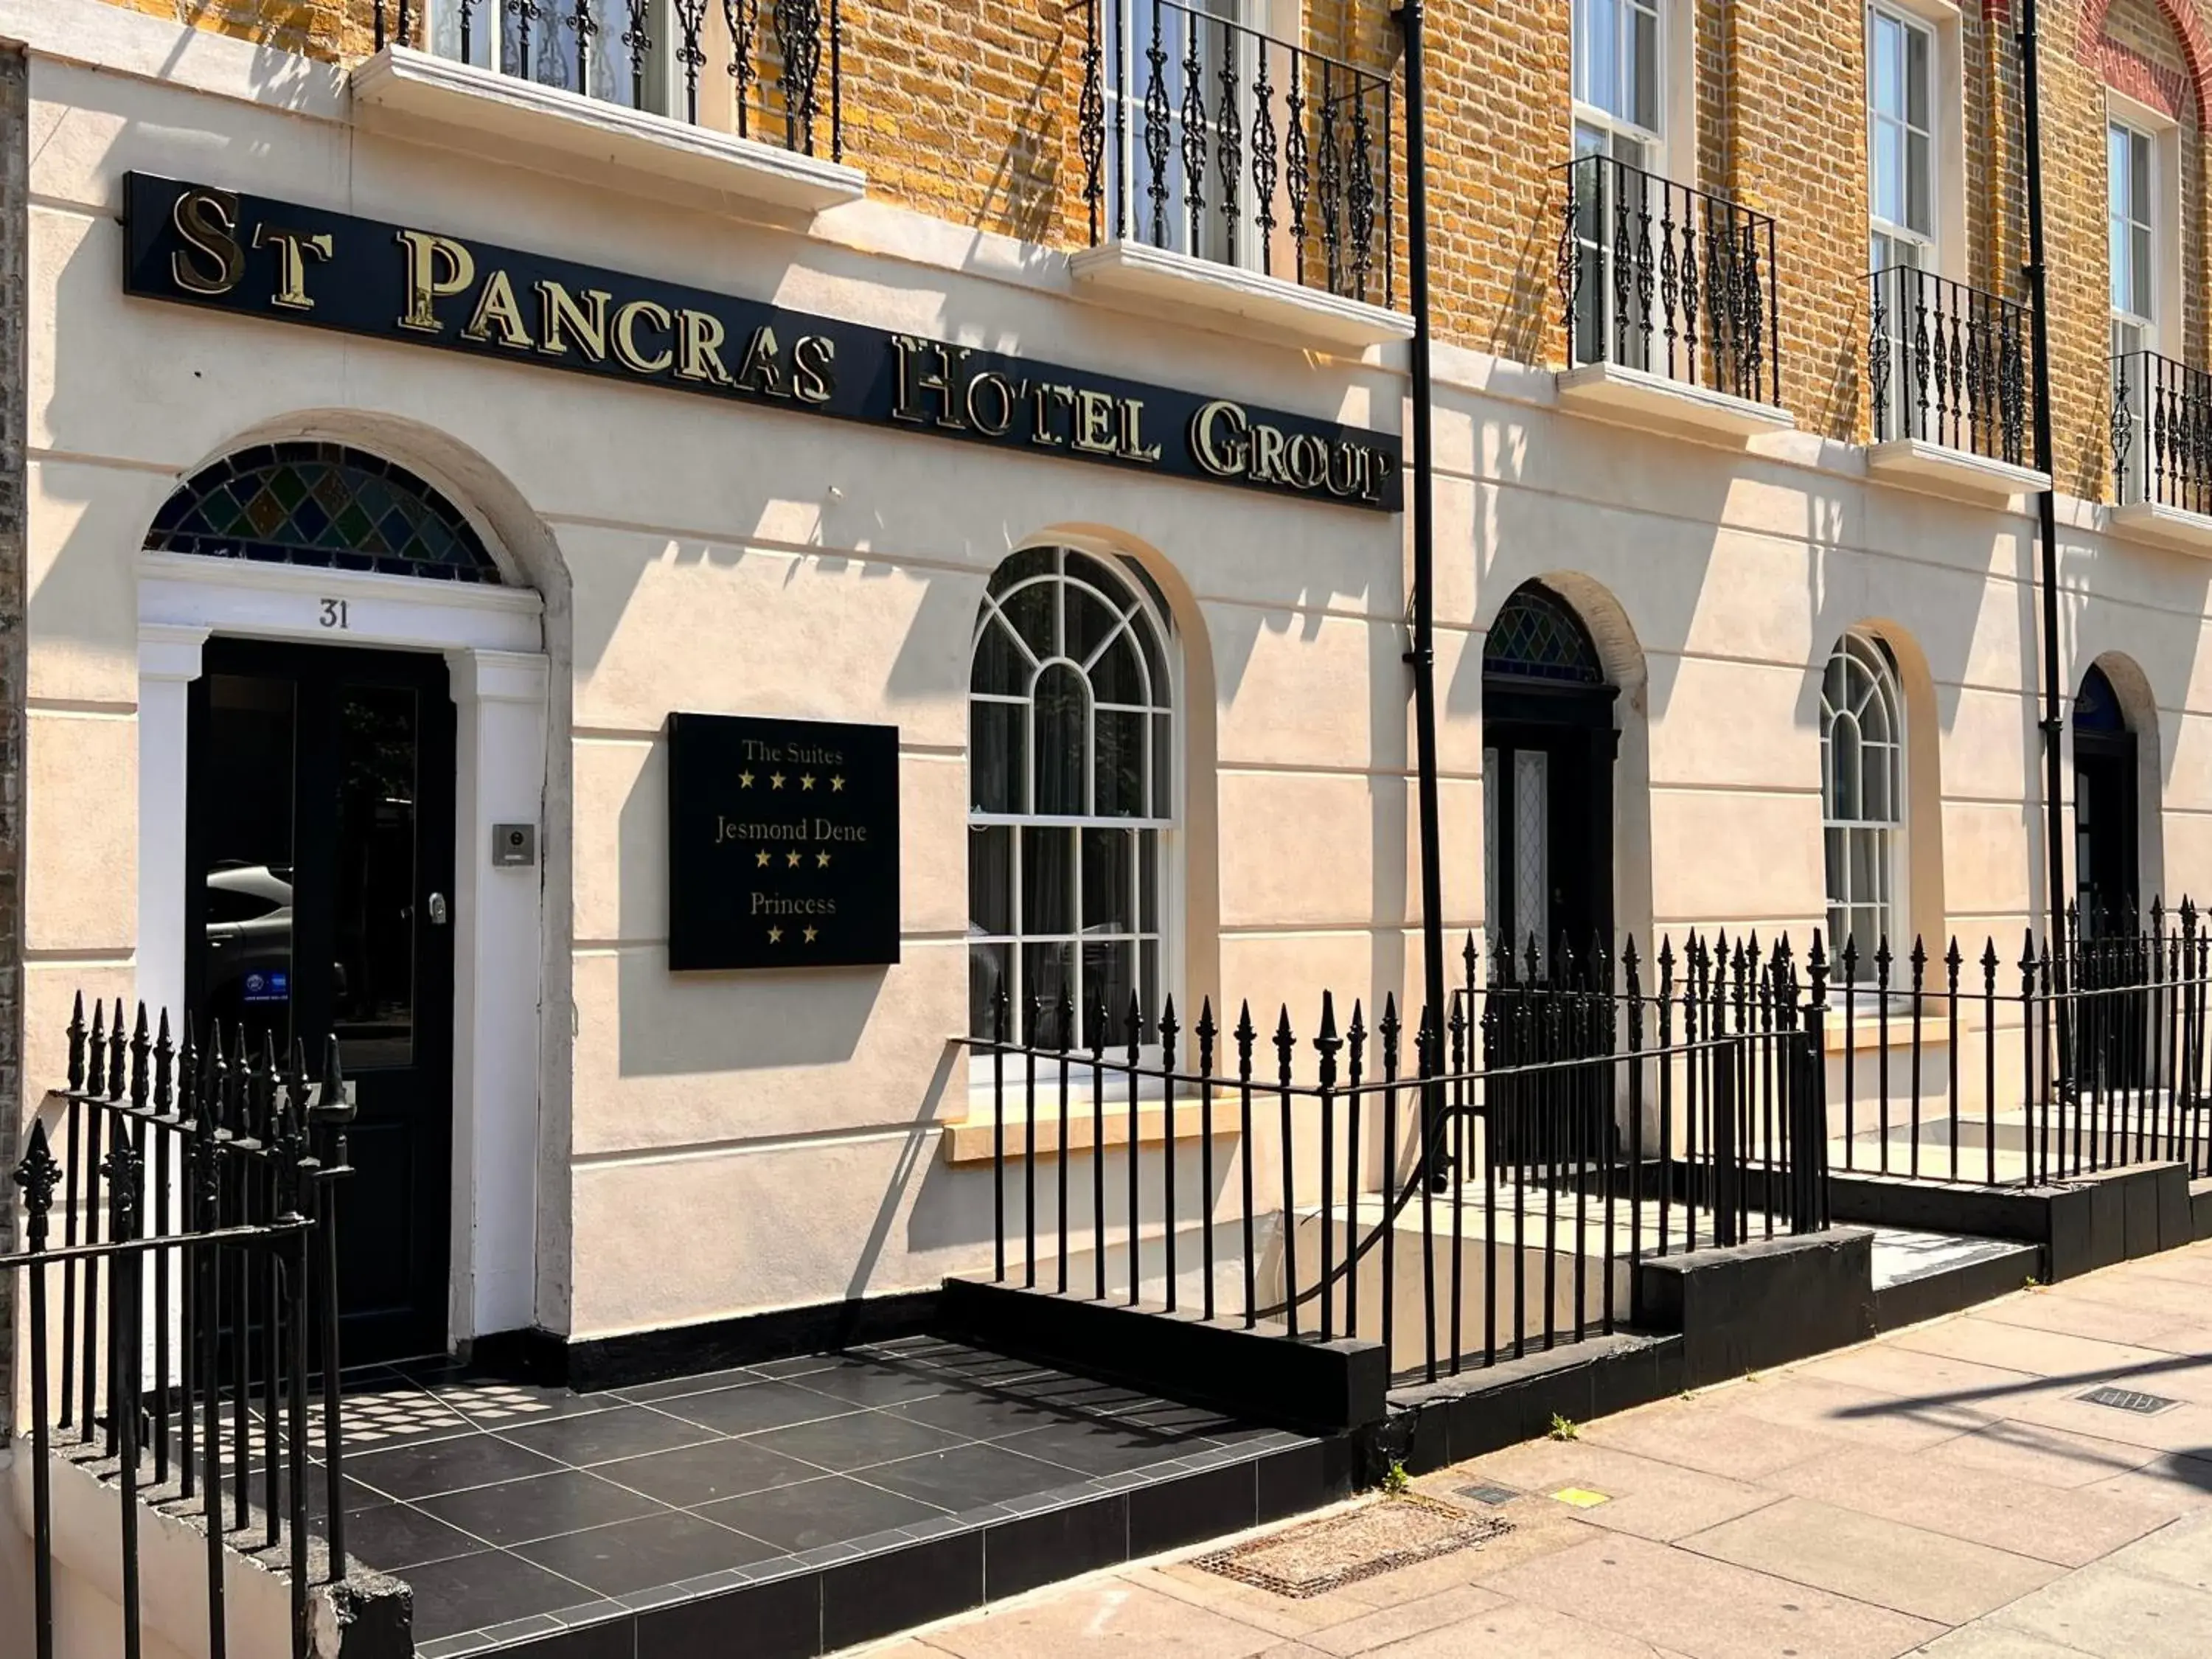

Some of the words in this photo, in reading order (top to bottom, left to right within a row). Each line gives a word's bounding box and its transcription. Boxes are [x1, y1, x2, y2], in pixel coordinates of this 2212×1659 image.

[319, 598, 347, 629] 31
[742, 740, 782, 762] The
[787, 742, 844, 765] Suites
[715, 815, 807, 843] Jesmond
[814, 818, 867, 841] Dene
[750, 892, 836, 915] Princess
